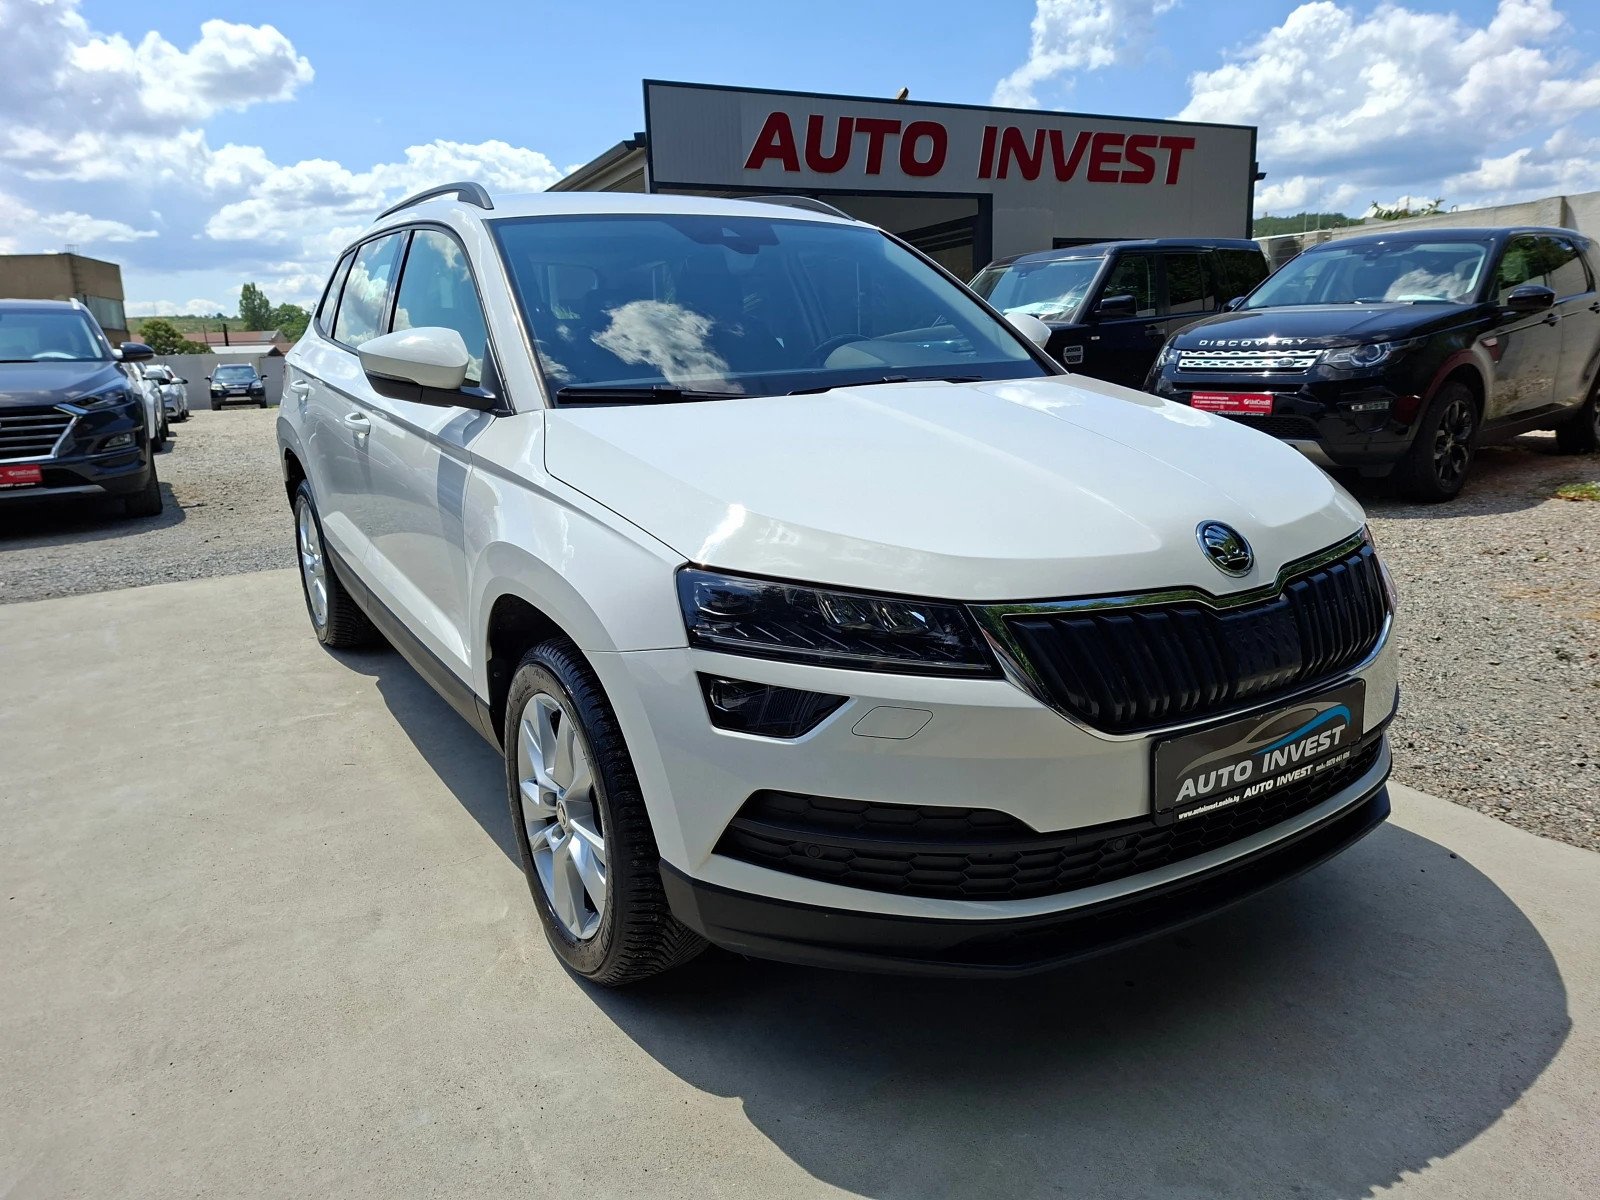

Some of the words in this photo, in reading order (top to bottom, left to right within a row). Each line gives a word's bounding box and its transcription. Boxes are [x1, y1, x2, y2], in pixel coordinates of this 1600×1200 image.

[743, 111, 948, 177] AUTO
[977, 125, 1196, 185] INVEST
[1198, 337, 1308, 347] DISCOVERY
[1175, 760, 1253, 802] AUTO
[1261, 724, 1346, 773] INVEST
[1243, 779, 1274, 799] AUTO
[1276, 764, 1314, 787] INVEST
